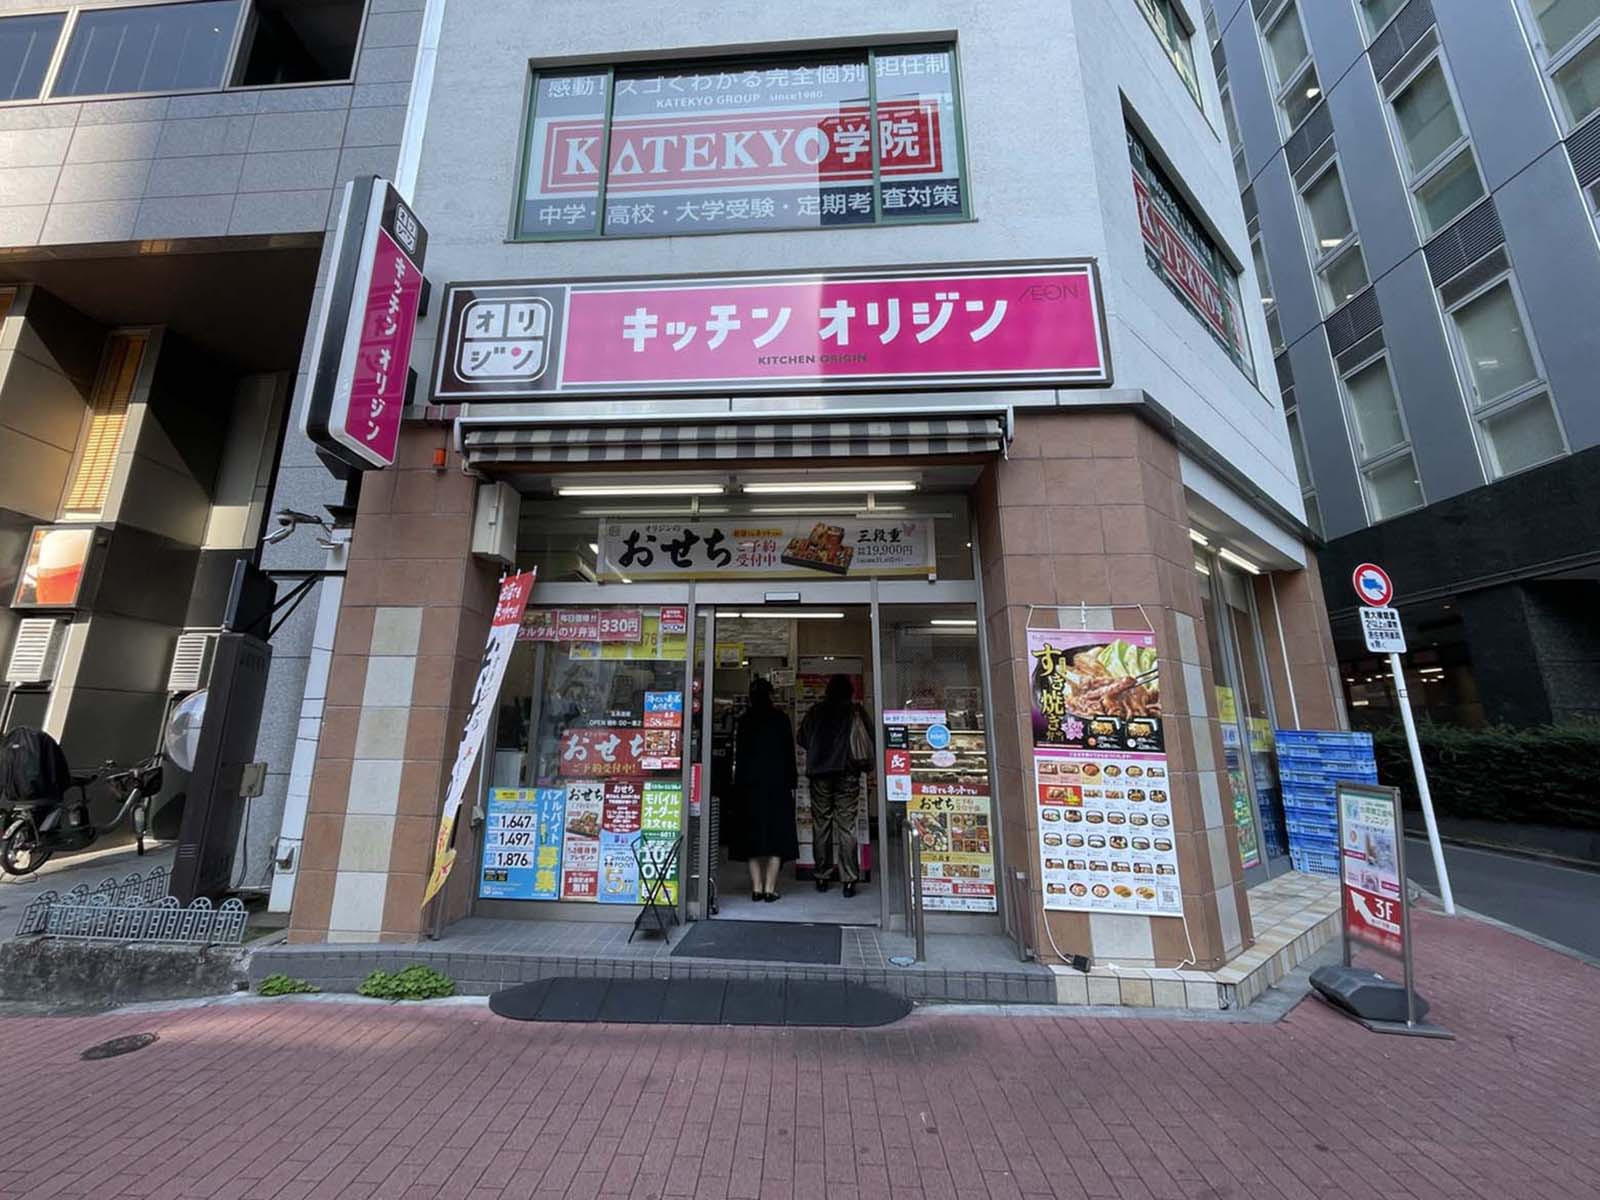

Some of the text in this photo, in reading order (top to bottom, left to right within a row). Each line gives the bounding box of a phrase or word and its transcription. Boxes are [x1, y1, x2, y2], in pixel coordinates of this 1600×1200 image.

[656, 97, 713, 109] KATEKYO
[716, 94, 761, 106] GROUP
[623, 292, 1008, 352] キッチン オリジン
[758, 353, 868, 365] KITCHEN ORIGIN
[618, 528, 731, 568] おせち
[601, 619, 639, 632] 330円
[569, 788, 603, 801] おせち
[920, 797, 955, 811] おせち
[498, 852, 528, 866] 1,876
[1375, 898, 1393, 922] 3F
